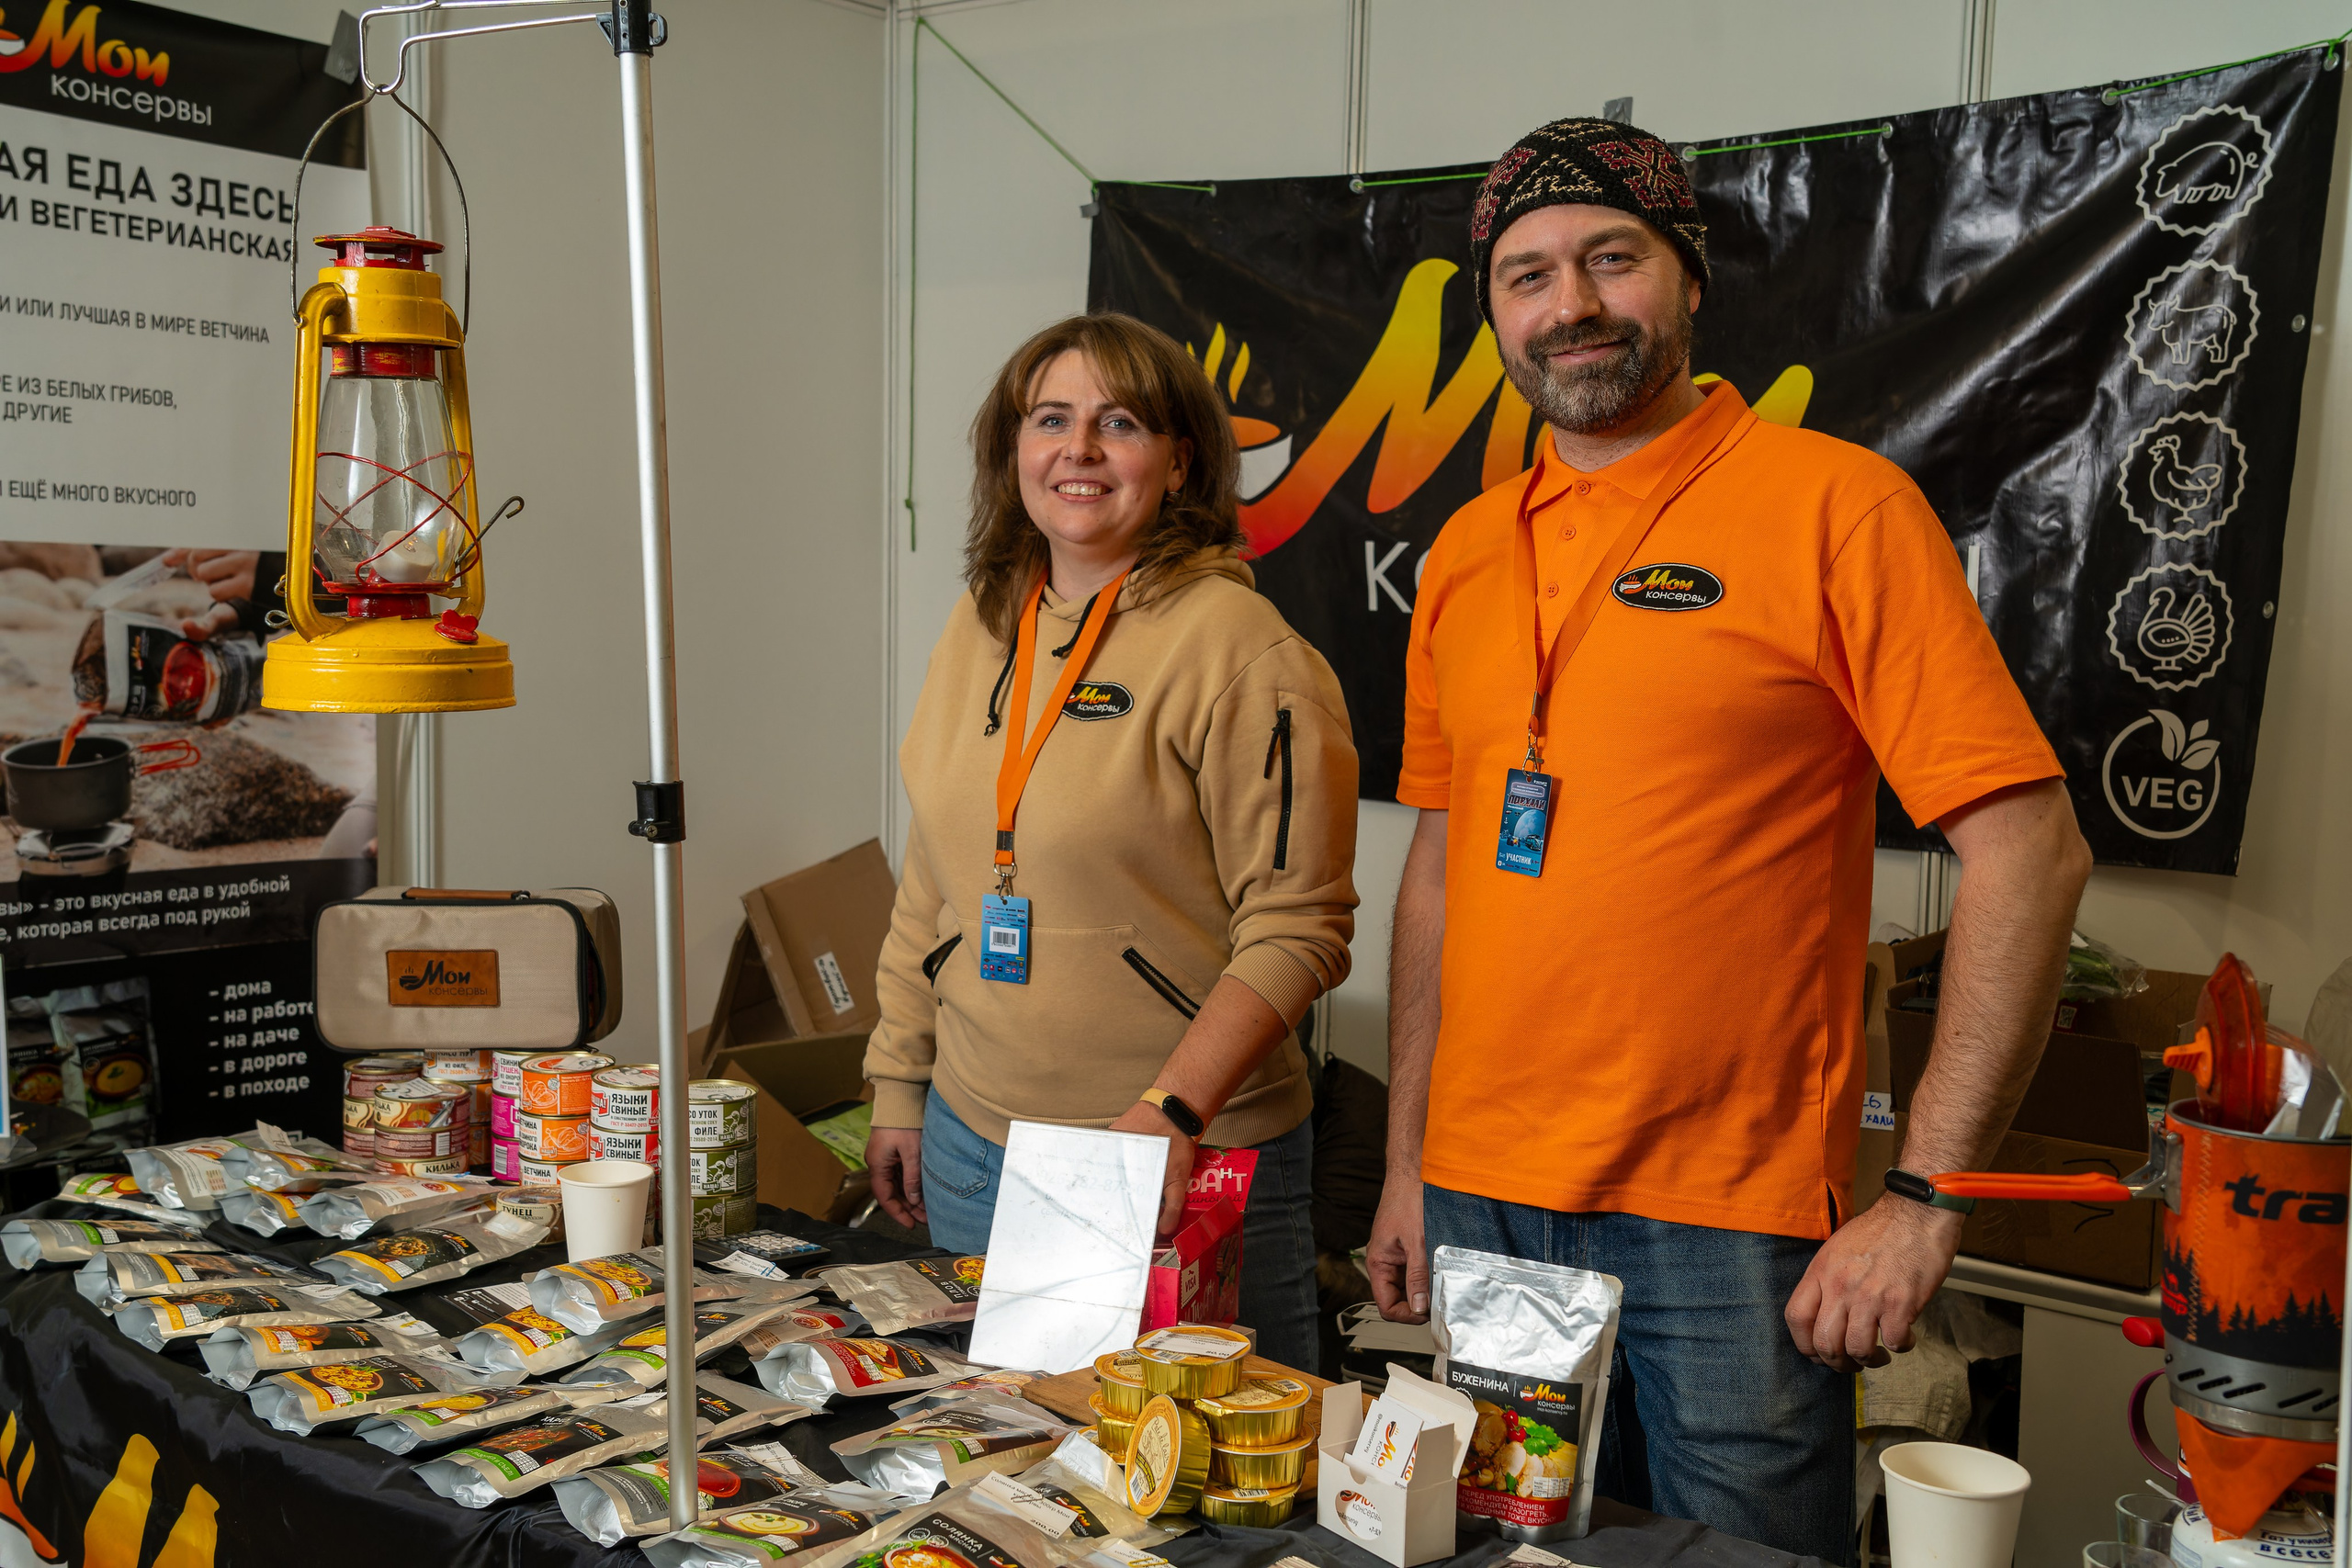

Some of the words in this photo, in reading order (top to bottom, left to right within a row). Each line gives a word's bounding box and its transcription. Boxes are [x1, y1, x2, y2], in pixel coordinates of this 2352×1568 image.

[14, 0, 170, 87] Мои
[51, 73, 212, 127] консервы
[67, 153, 156, 203] ЕДА
[171, 173, 300, 223] ЗДЕСЬ
[31, 198, 299, 264] ВЕГЕТЕРИАНСКАЯ
[17, 297, 54, 319] ИЛИ
[60, 303, 130, 328] ЛУЧШАЯ
[136, 311, 147, 330] В
[152, 314, 196, 336] МИРЕ
[200, 320, 270, 344] ВЕТЧИНА
[18, 376, 41, 395] ИЗ
[47, 378, 106, 402] БЕЛЫХ
[111, 385, 177, 410] ГРИБОВ,
[4, 401, 73, 424] ДРУГИЕ
[9, 479, 47, 502] ЕЩЁ
[52, 483, 108, 503] МНОГО
[115, 487, 196, 508] ВКУСНОГО
[1635, 569, 1694, 592] Мои
[1645, 591, 1707, 604] консервы
[1071, 686, 1112, 705] Мои
[1078, 703, 1120, 713] консервы
[2121, 774, 2203, 812] VEG
[1506, 852, 1532, 865] УЧАСТНИК
[54, 896, 85, 912] это
[90, 888, 163, 910] вкусная
[167, 885, 199, 903] еда
[203, 884, 215, 898] в
[219, 874, 290, 902] удобной
[17, 919, 93, 939] которая
[97, 915, 160, 932] всегда
[164, 910, 197, 927] под
[201, 901, 251, 924] рукой
[416, 960, 470, 987] Мои
[223, 979, 272, 1001] дома
[428, 986, 488, 997] консервы
[223, 1009, 246, 1024] на
[223, 1033, 246, 1049] на
[252, 1027, 300, 1048] даче
[223, 1059, 235, 1074] в
[241, 1049, 308, 1074] дороге
[223, 1085, 235, 1099] в
[241, 1075, 310, 1097] походе
[612, 1093, 648, 1105] ЯЗЫКИ
[611, 1105, 648, 1116] СВИНЫЕ
[698, 1110, 718, 1119] УТОК
[695, 1126, 718, 1136] ФИЛЕ
[606, 1136, 641, 1149] ЯЗЫКИ
[606, 1148, 641, 1160] СВИНЫЕ
[425, 1160, 460, 1174] КИЛЬКА
[524, 1166, 551, 1178] ВЕТЧИНА
[502, 1205, 533, 1217] ТУНЕЦ
[1452, 1371, 1510, 1393] БУЖЕНИНА
[1532, 1382, 1566, 1404] Мои
[710, 1397, 731, 1412] Мои
[1537, 1400, 1576, 1411] консервы
[582, 1427, 605, 1442] консервы
[585, 1423, 607, 1437] Мои
[990, 1475, 1015, 1490] Солянка
[1458, 1494, 1508, 1510] РЕКОМЕНДУЕМ
[1462, 1489, 1485, 1500] ПЕРЕД
[1486, 1494, 1545, 1511] УПОТРЕБЛЕНИЕМ
[1465, 1503, 1507, 1517] ХОЛОДНЫМ
[1508, 1511, 1526, 1523] ТОЖЕ
[933, 1518, 983, 1551] СОЛЯНКА
[948, 1533, 978, 1553] МЯСНАЯ
[2260, 1531, 2285, 1542] Газ
